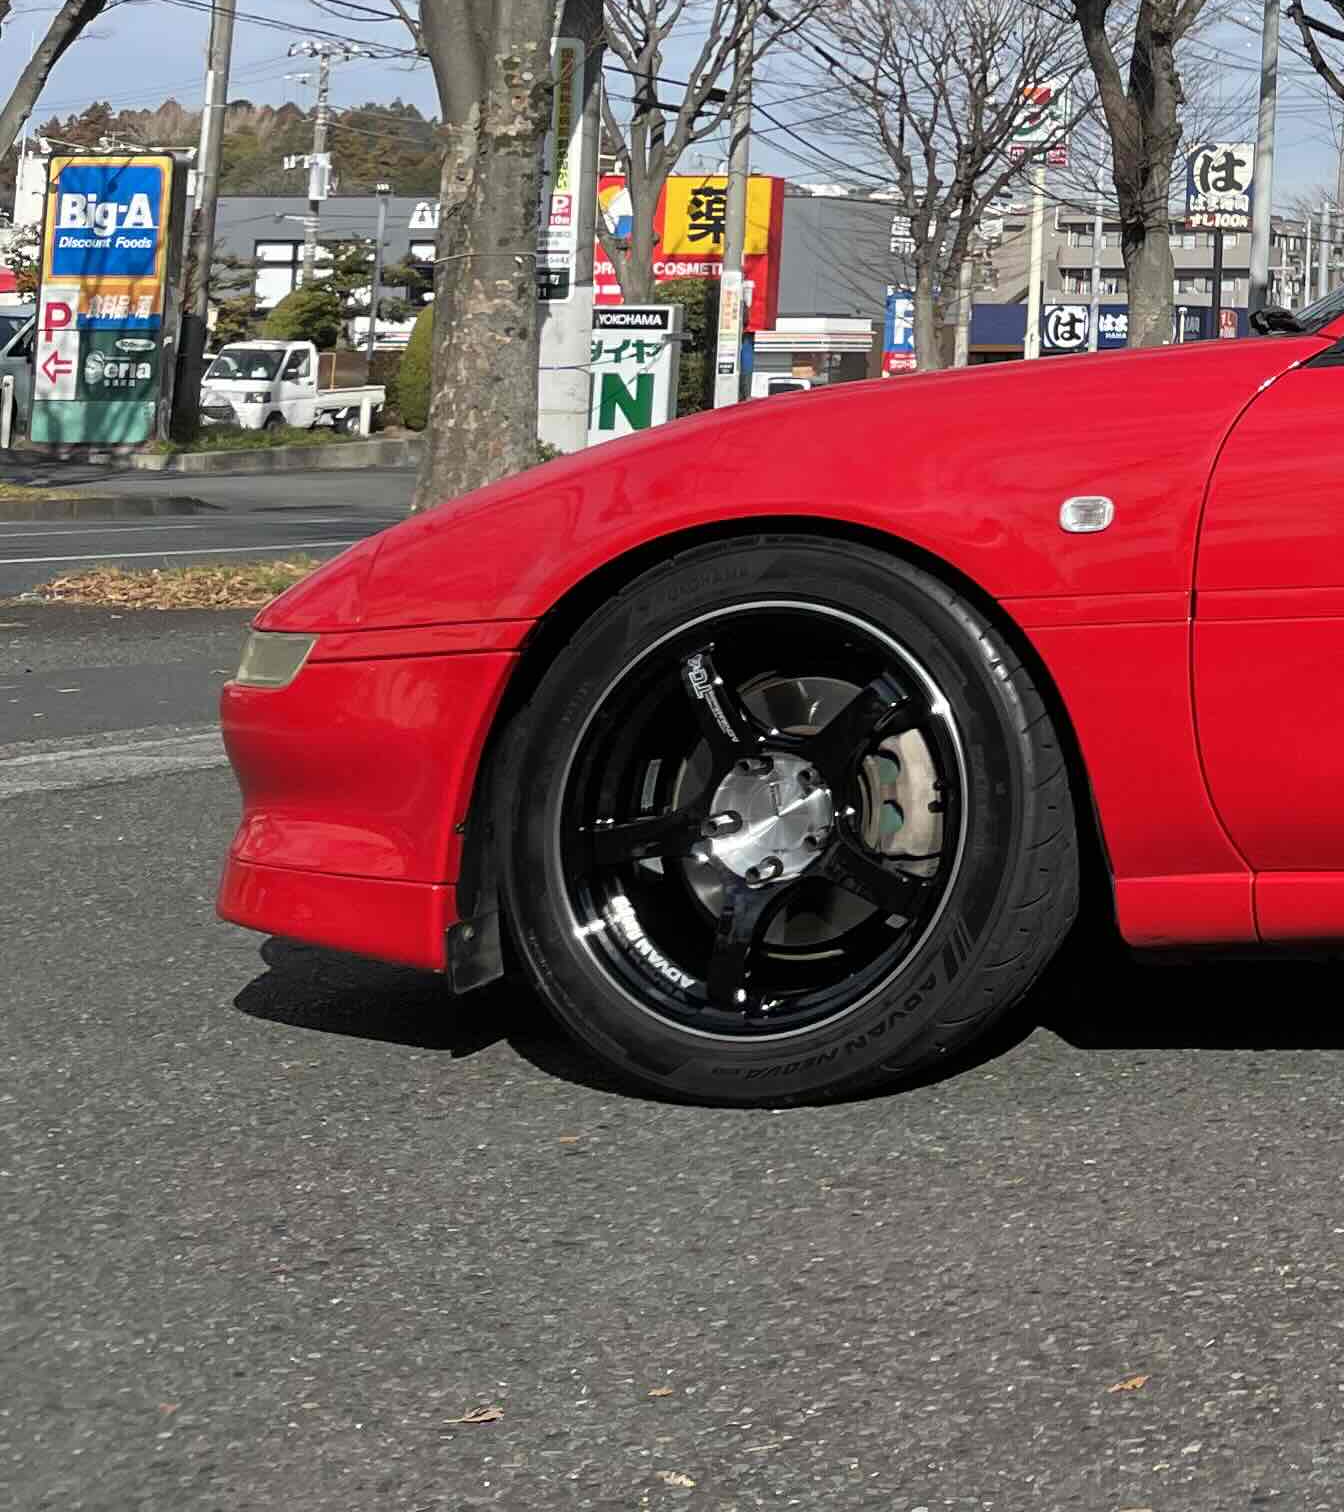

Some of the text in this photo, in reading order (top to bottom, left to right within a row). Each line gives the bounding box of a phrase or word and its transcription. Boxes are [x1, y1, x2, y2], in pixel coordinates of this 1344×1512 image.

[1199, 151, 1247, 193] は
[60, 193, 153, 237] Big-A
[59, 236, 152, 249] Discount Foods
[653, 263, 724, 276] COSMETI
[45, 302, 72, 343] P
[598, 313, 662, 327] YOKOHAMA
[1053, 313, 1083, 342] は
[634, 937, 697, 989] ADVAN
